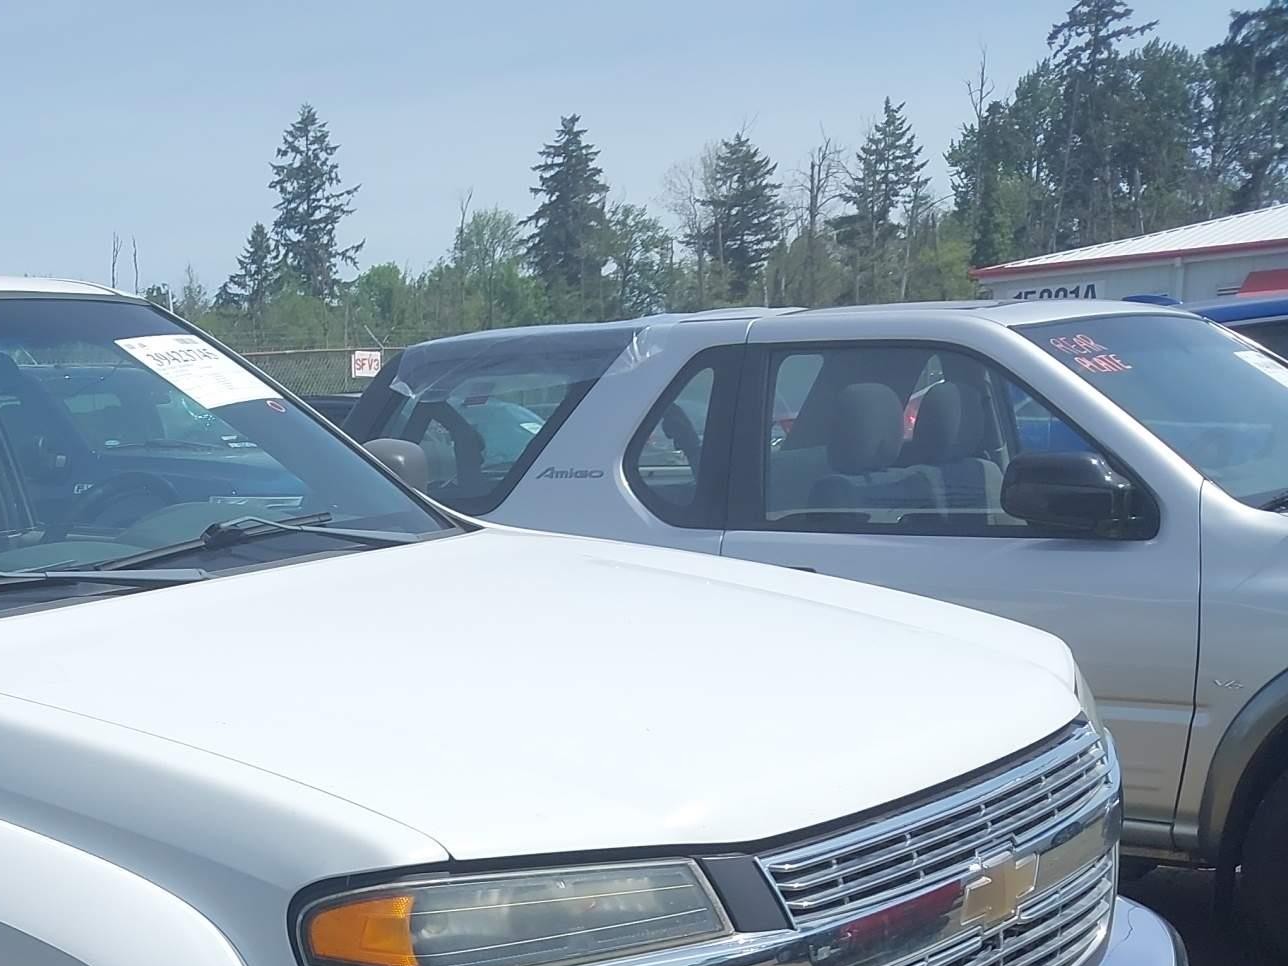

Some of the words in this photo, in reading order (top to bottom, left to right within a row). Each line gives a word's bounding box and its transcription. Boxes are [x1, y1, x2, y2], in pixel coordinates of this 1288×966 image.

[146, 348, 221, 367] 39423745
[354, 358, 380, 371] SFV3
[1074, 354, 1132, 373] PLATE
